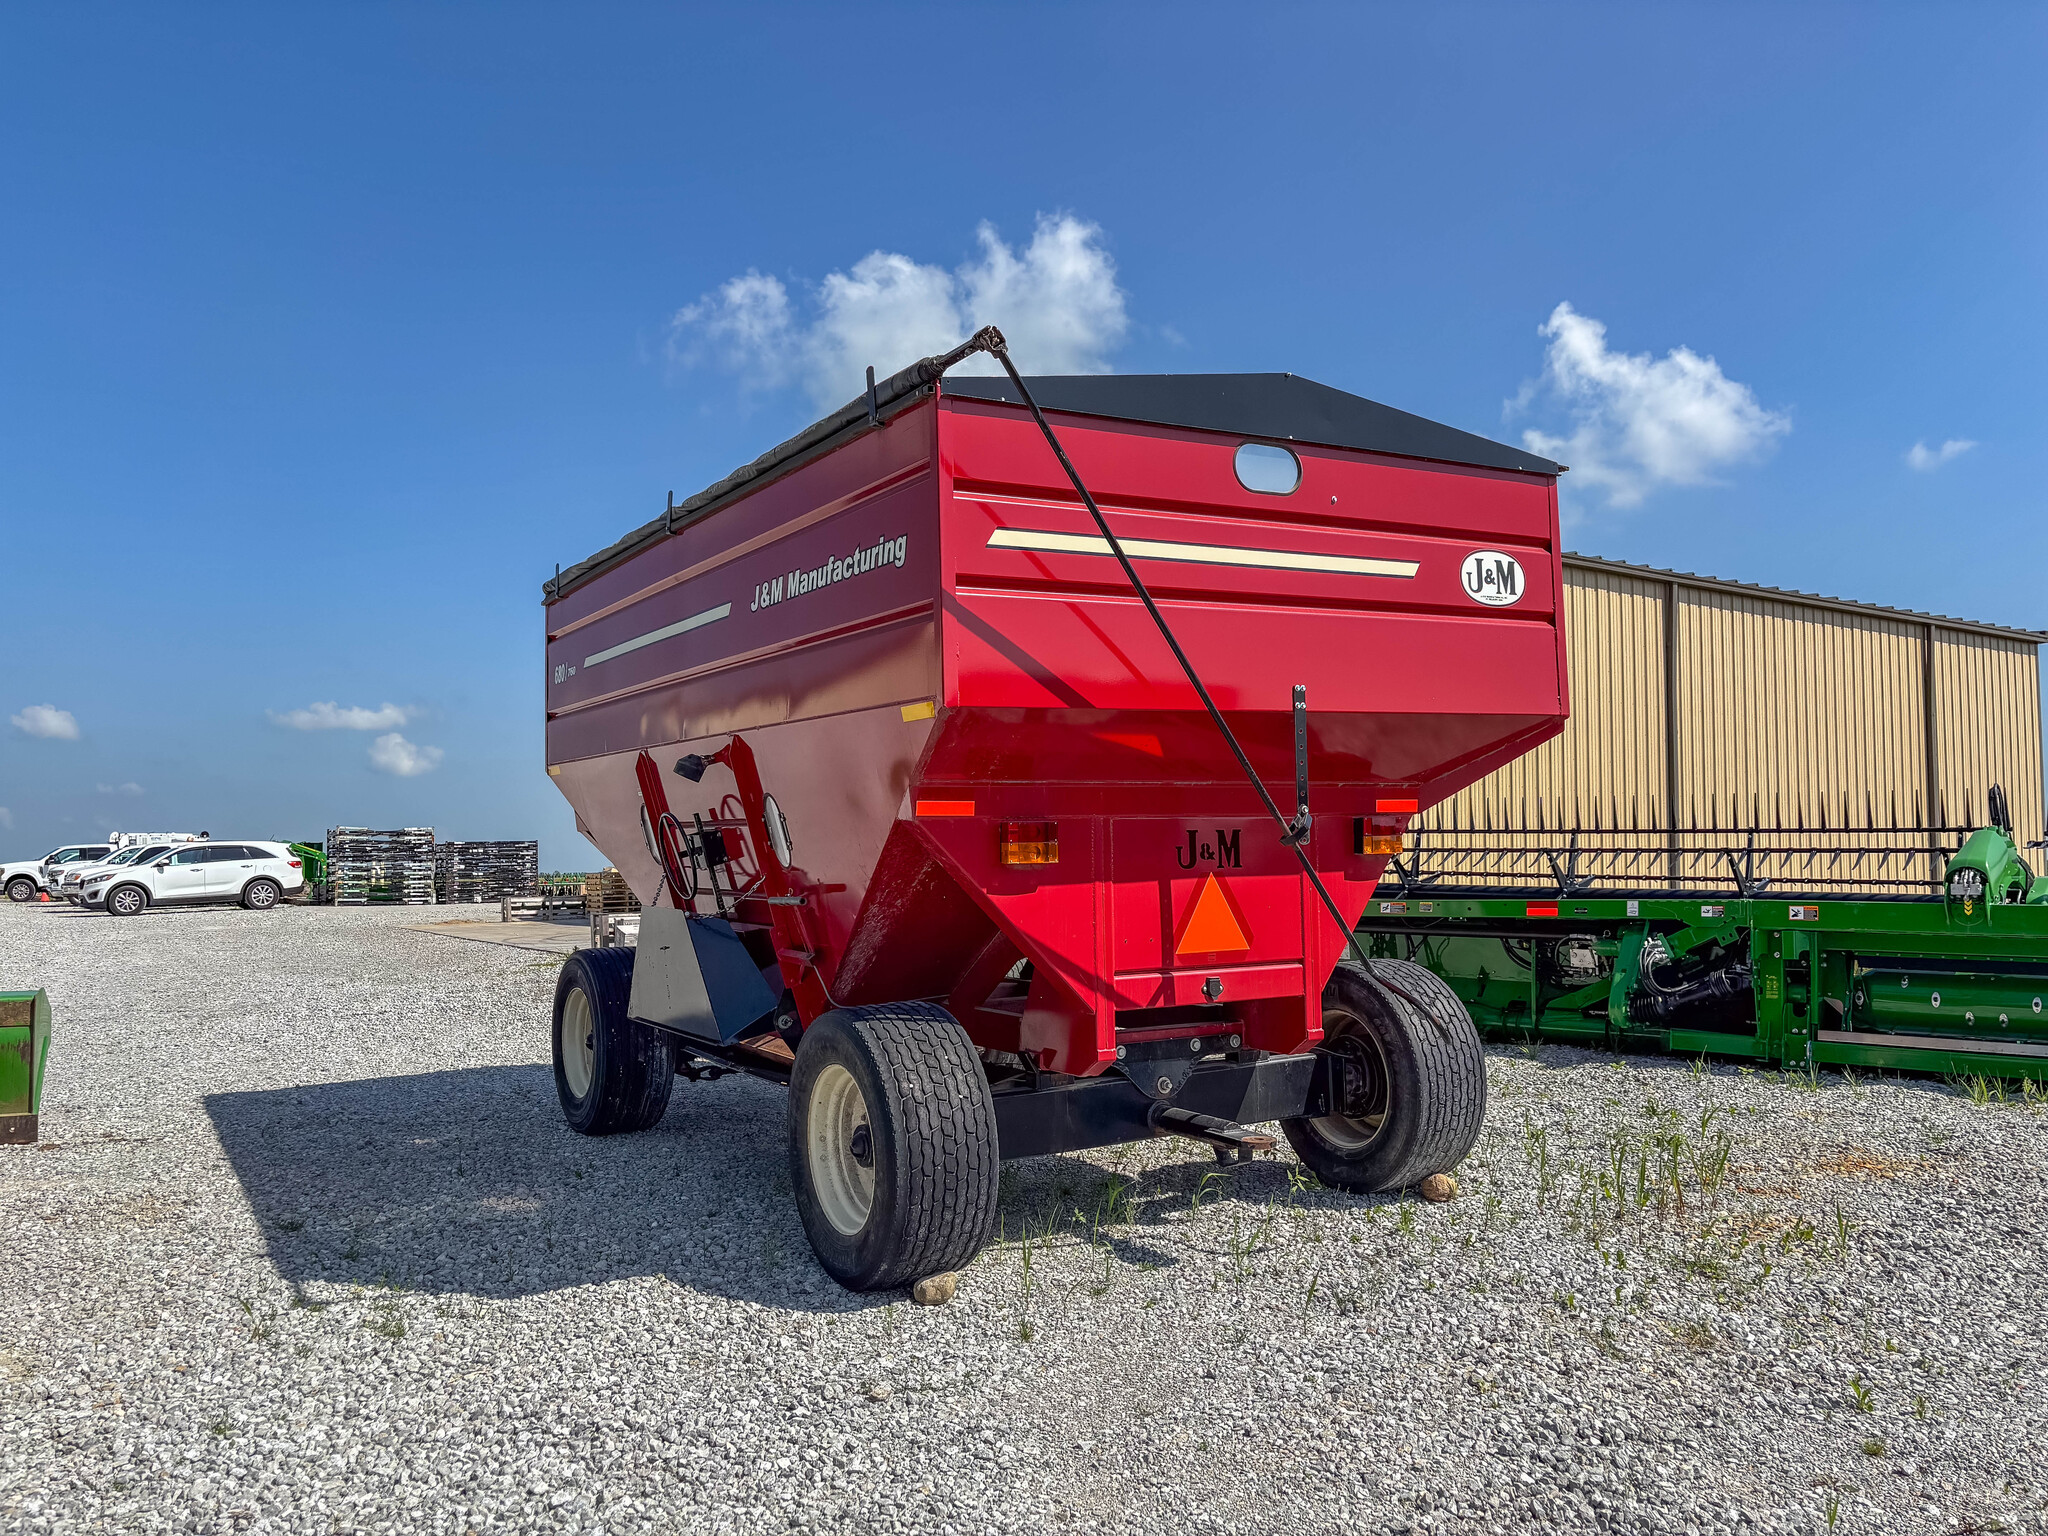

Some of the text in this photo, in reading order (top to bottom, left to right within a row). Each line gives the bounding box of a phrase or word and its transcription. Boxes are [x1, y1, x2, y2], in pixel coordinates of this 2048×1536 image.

[750, 534, 908, 612] J&M Manufacturing
[1466, 558, 1518, 595] J&M
[1175, 829, 1243, 869] J&M
